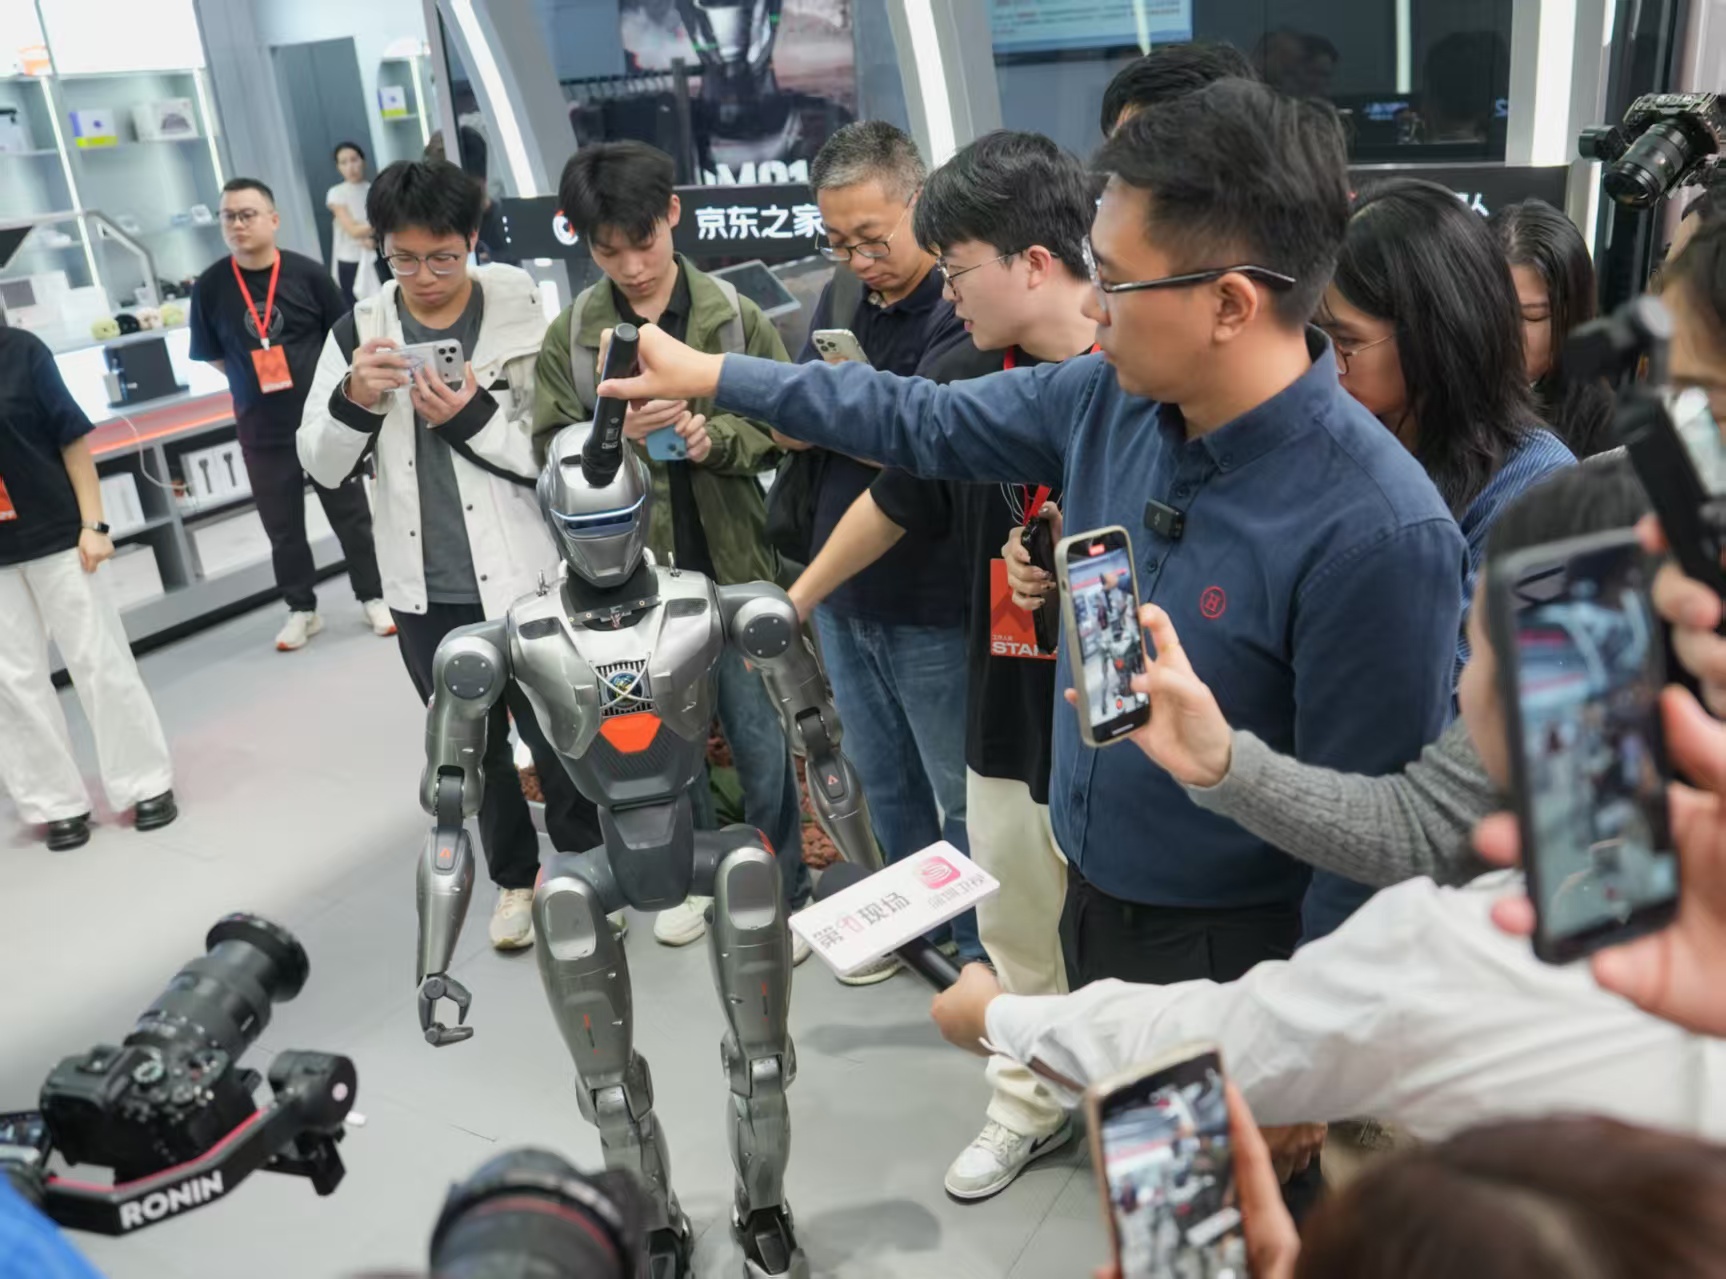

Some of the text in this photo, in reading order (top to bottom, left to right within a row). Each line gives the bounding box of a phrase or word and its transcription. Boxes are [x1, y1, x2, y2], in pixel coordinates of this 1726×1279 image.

[696, 159, 809, 185] M01
[695, 204, 827, 240] 京东之家
[120, 1169, 224, 1230] RONIN
